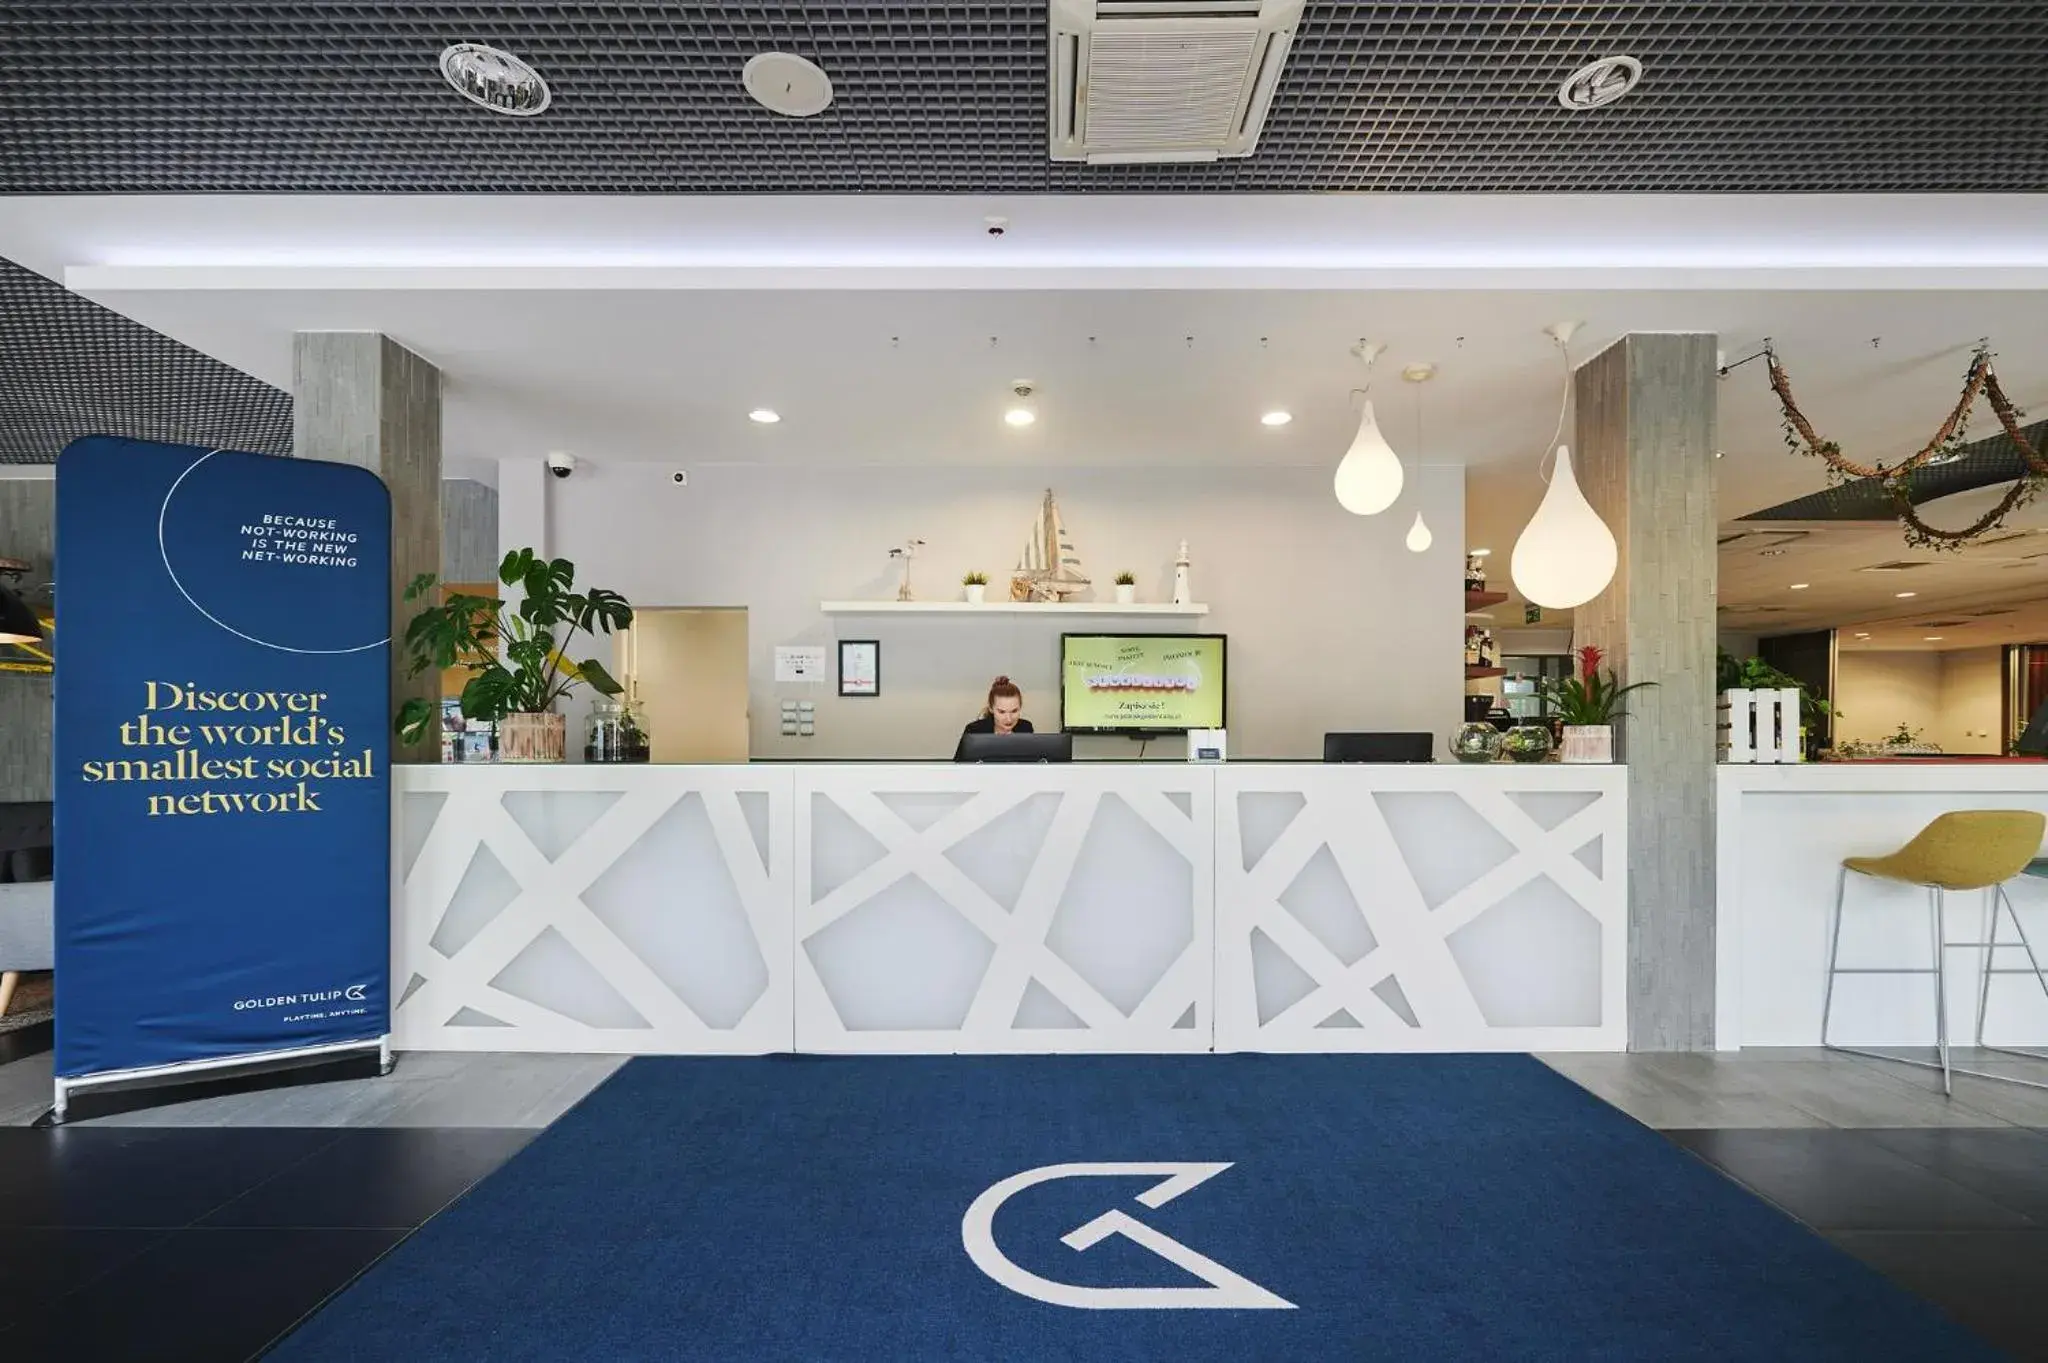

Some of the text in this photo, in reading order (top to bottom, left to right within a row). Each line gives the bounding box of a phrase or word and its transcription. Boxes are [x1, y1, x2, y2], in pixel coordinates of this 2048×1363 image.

[262, 514, 337, 530] BECAUSE
[240, 524, 358, 543] NOT-WORKING
[252, 538, 348, 554] IS THE NEW
[242, 550, 358, 567] NET-WORKING
[144, 681, 327, 713] Discover
[120, 714, 191, 746] the
[83, 749, 374, 782] smallest social
[148, 782, 322, 816] network
[233, 990, 342, 1010] GOLDEN TULIP
